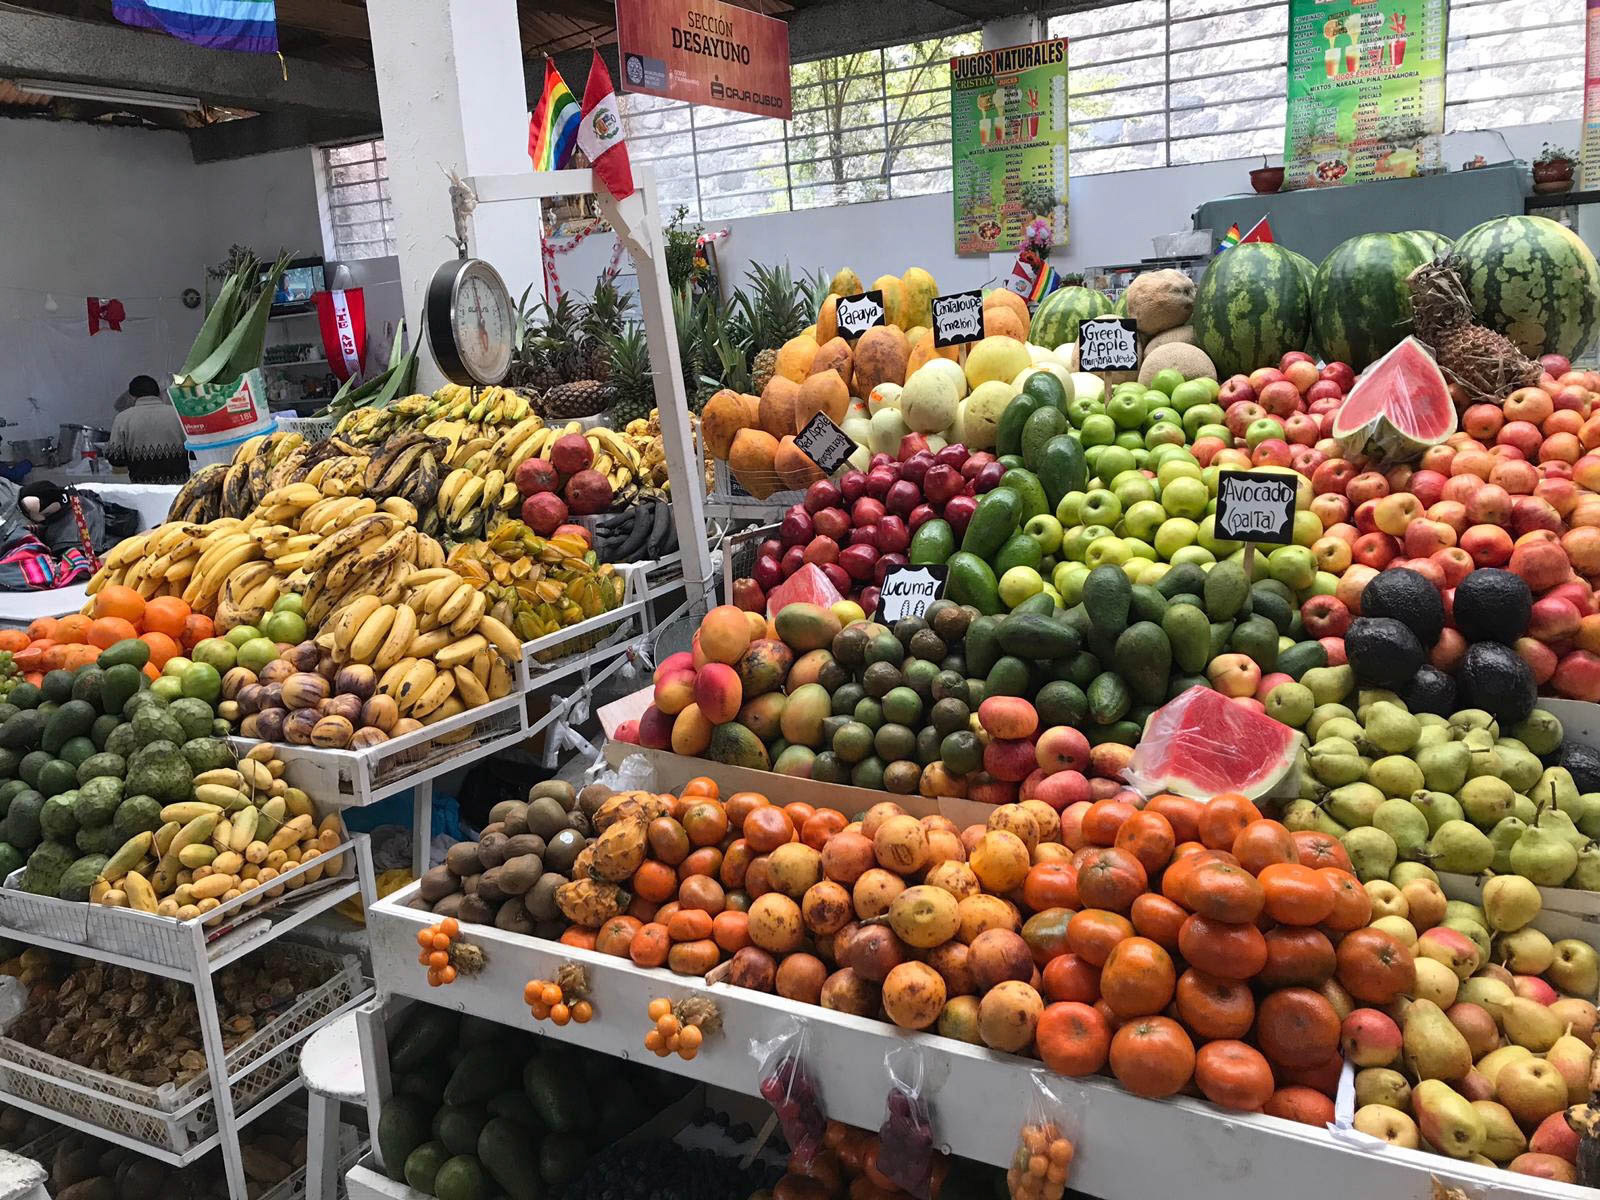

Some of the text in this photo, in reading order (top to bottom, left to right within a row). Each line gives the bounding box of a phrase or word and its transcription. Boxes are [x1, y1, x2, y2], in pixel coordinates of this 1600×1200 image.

[688, 10, 733, 37] SECCIÓN
[671, 28, 750, 65] DESAYUNO
[954, 41, 1064, 79] JUGOS NATURALES
[956, 77, 993, 89] CRISTINA
[1383, 70, 1420, 81] ZANAHORIA
[725, 86, 783, 108] CAJA CUSCO
[838, 304, 878, 327] Papaya
[939, 314, 977, 334] (melón)
[336, 313, 355, 355] TE AMO
[1085, 323, 1123, 341] Green
[1087, 339, 1129, 357] Apple
[798, 415, 831, 451] Red Apple
[1225, 478, 1293, 503] Avocado
[881, 574, 935, 597] Lucuma
